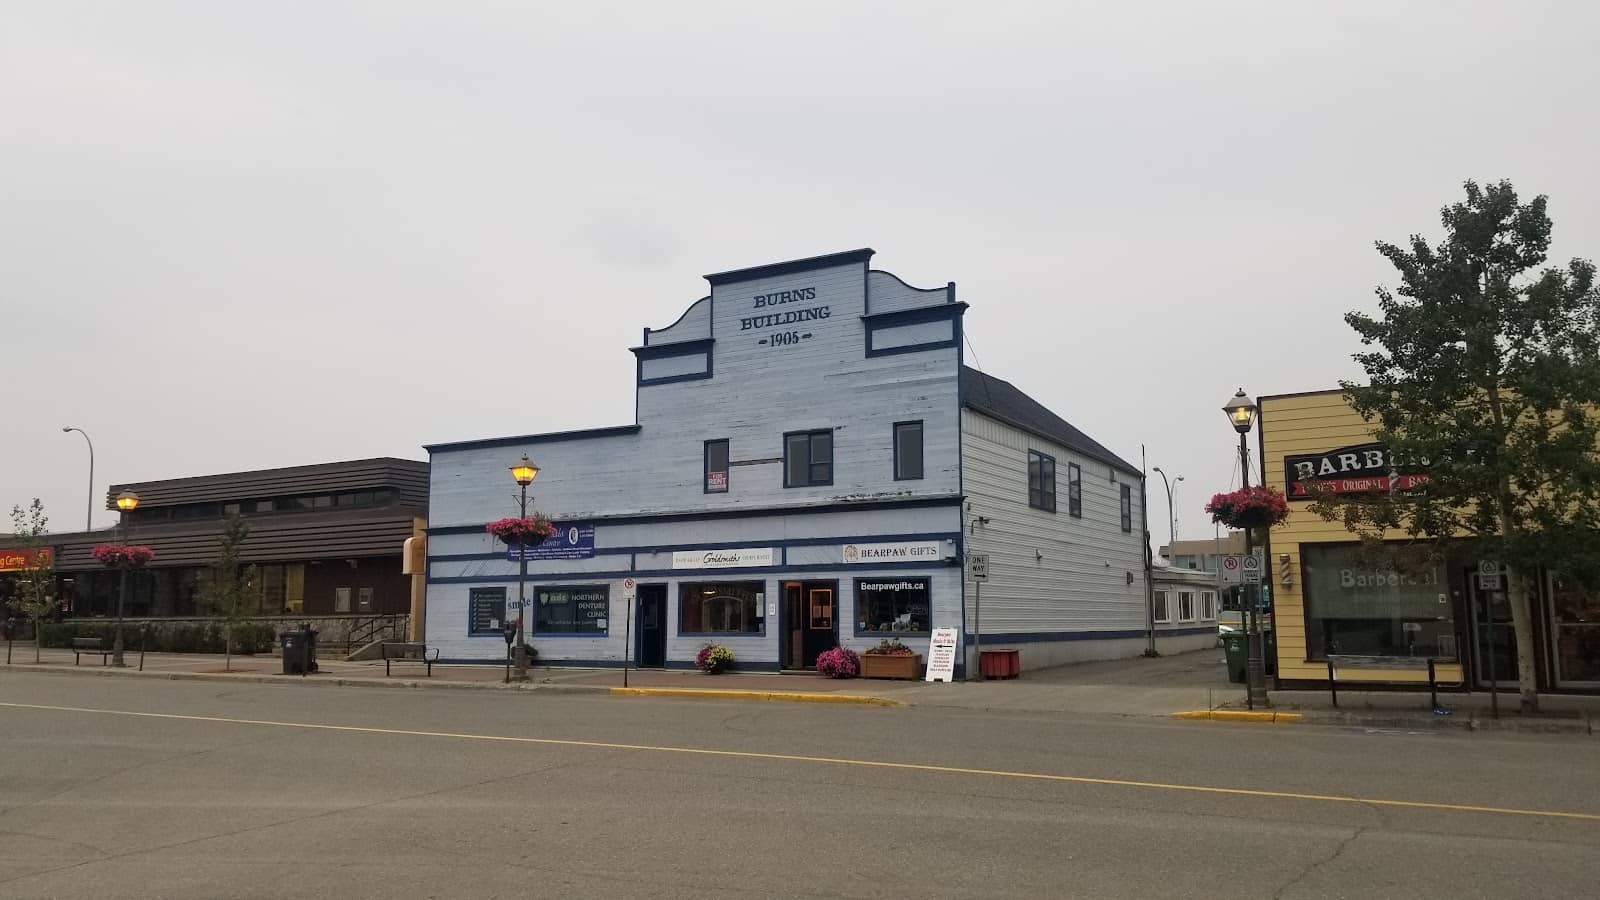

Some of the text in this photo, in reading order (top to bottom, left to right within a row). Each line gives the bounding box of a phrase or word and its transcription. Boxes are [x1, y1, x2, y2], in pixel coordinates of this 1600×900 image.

[753, 287, 816, 308] BURNS
[740, 306, 831, 330] BUILDING
[861, 546, 937, 558] BEARPAW GIFTS
[972, 556, 985, 564] ONE
[860, 582, 924, 592] Bearpawgifts.ca
[571, 592, 605, 601] NORTHERN
